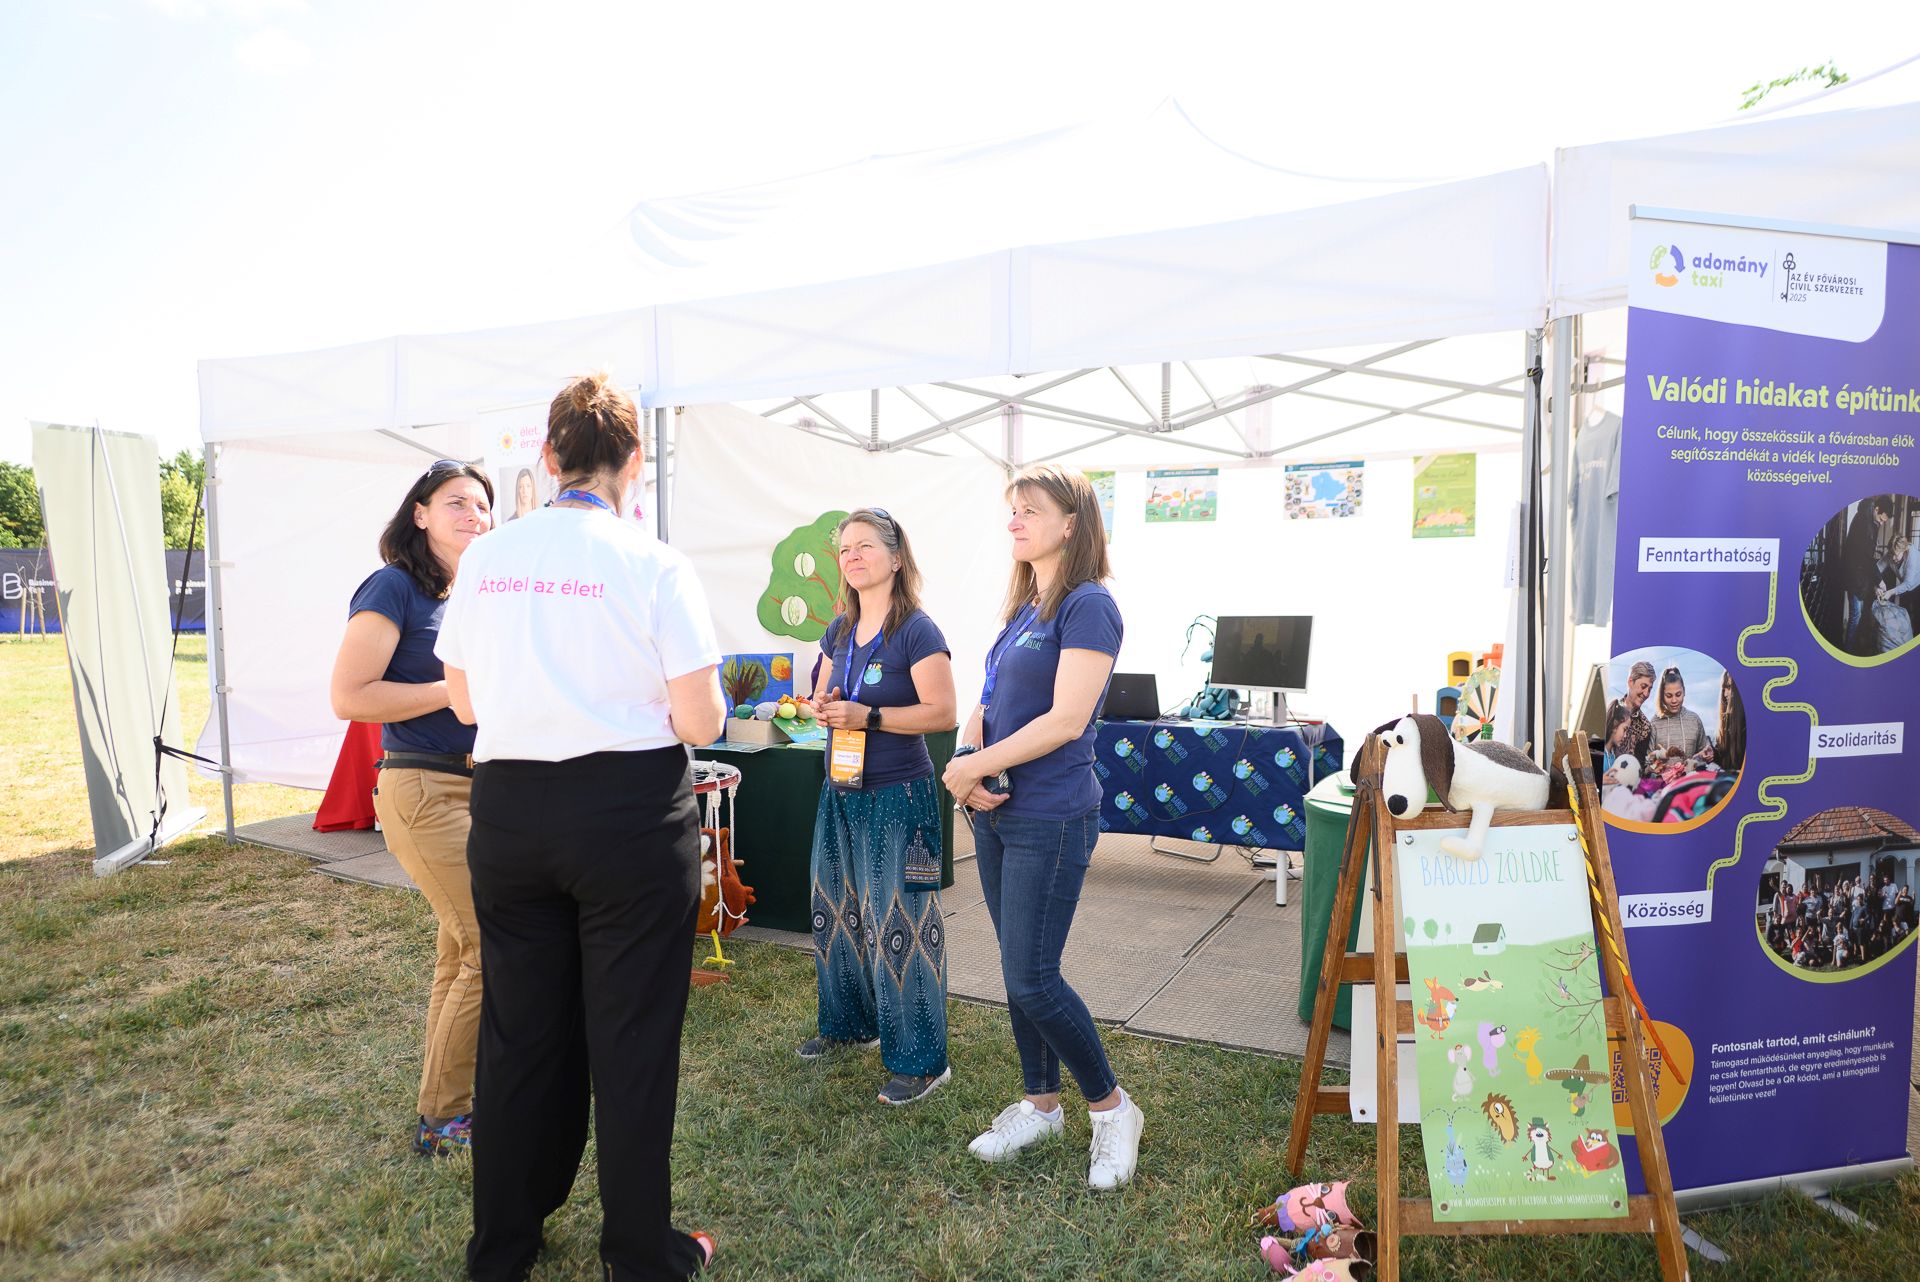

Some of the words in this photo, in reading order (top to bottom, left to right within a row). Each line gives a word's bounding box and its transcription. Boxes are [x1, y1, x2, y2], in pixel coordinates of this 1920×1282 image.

[1692, 252, 1768, 278] adomány
[1691, 271, 1724, 288] taxi
[1790, 273, 1802, 282] AZ
[1804, 271, 1815, 283] ÉV
[1816, 272, 1857, 286] FŐVÁROSI
[1788, 293, 1807, 303] 2025
[1789, 282, 1812, 293] CIVIL
[1814, 284, 1864, 296] SZERVEZETE
[1646, 375, 1727, 404] Valódi
[1735, 378, 1829, 409] hidakat
[1835, 383, 1920, 416] építünk
[1656, 425, 1701, 442] Célunk,
[1704, 427, 1739, 444] hogy
[1741, 428, 1815, 445] összekössük
[1817, 433, 1826, 444] a
[1828, 431, 1889, 447] fővárosban
[1891, 432, 1915, 448] élők
[1670, 447, 1770, 463] segítőszándékát
[1771, 453, 1779, 463] a
[1781, 449, 1815, 464] vidék
[1818, 449, 1900, 467] legrászorulóbb
[1746, 468, 1833, 486] közösségeivel.
[1645, 547, 1771, 566] Fenntarthatóság
[478, 576, 529, 594] Átölel
[533, 581, 556, 594] az
[560, 579, 604, 598] élet!
[1817, 729, 1897, 749] Szolidaritás
[1494, 848, 1565, 884] ZÖLDRE
[1627, 900, 1704, 919] Közösség
[1711, 1038, 1764, 1054] Fontosnak
[1766, 1035, 1800, 1048] tartod,
[1802, 1032, 1826, 1045] amit
[1827, 1026, 1876, 1043] csinálunk?
[1710, 1056, 1749, 1070] Támogasd
[1750, 1051, 1805, 1064] működésünket
[1806, 1047, 1844, 1060] anyagilag,
[1844, 1045, 1862, 1056] hogy
[1862, 1040, 1895, 1053] munkánk
[1710, 1073, 1720, 1081] ne
[1721, 1070, 1739, 1080] csak
[1740, 1065, 1787, 1078] fenntartható,
[1788, 1063, 1799, 1072] de
[1800, 1061, 1823, 1073] egyre
[1823, 1053, 1879, 1069] eredményesebb
[1880, 1052, 1887, 1061] is
[1709, 1081, 1737, 1093] legyen!
[1738, 1078, 1764, 1089] Olvasd
[1765, 1077, 1775, 1086] be
[1783, 1075, 1796, 1085] QR
[1797, 1072, 1821, 1083] kódot,
[1822, 1071, 1835, 1080] ami
[1842, 1064, 1880, 1078] támogatási
[1709, 1091, 1754, 1105] felületünkre
[1754, 1088, 1777, 1099] vezet!
